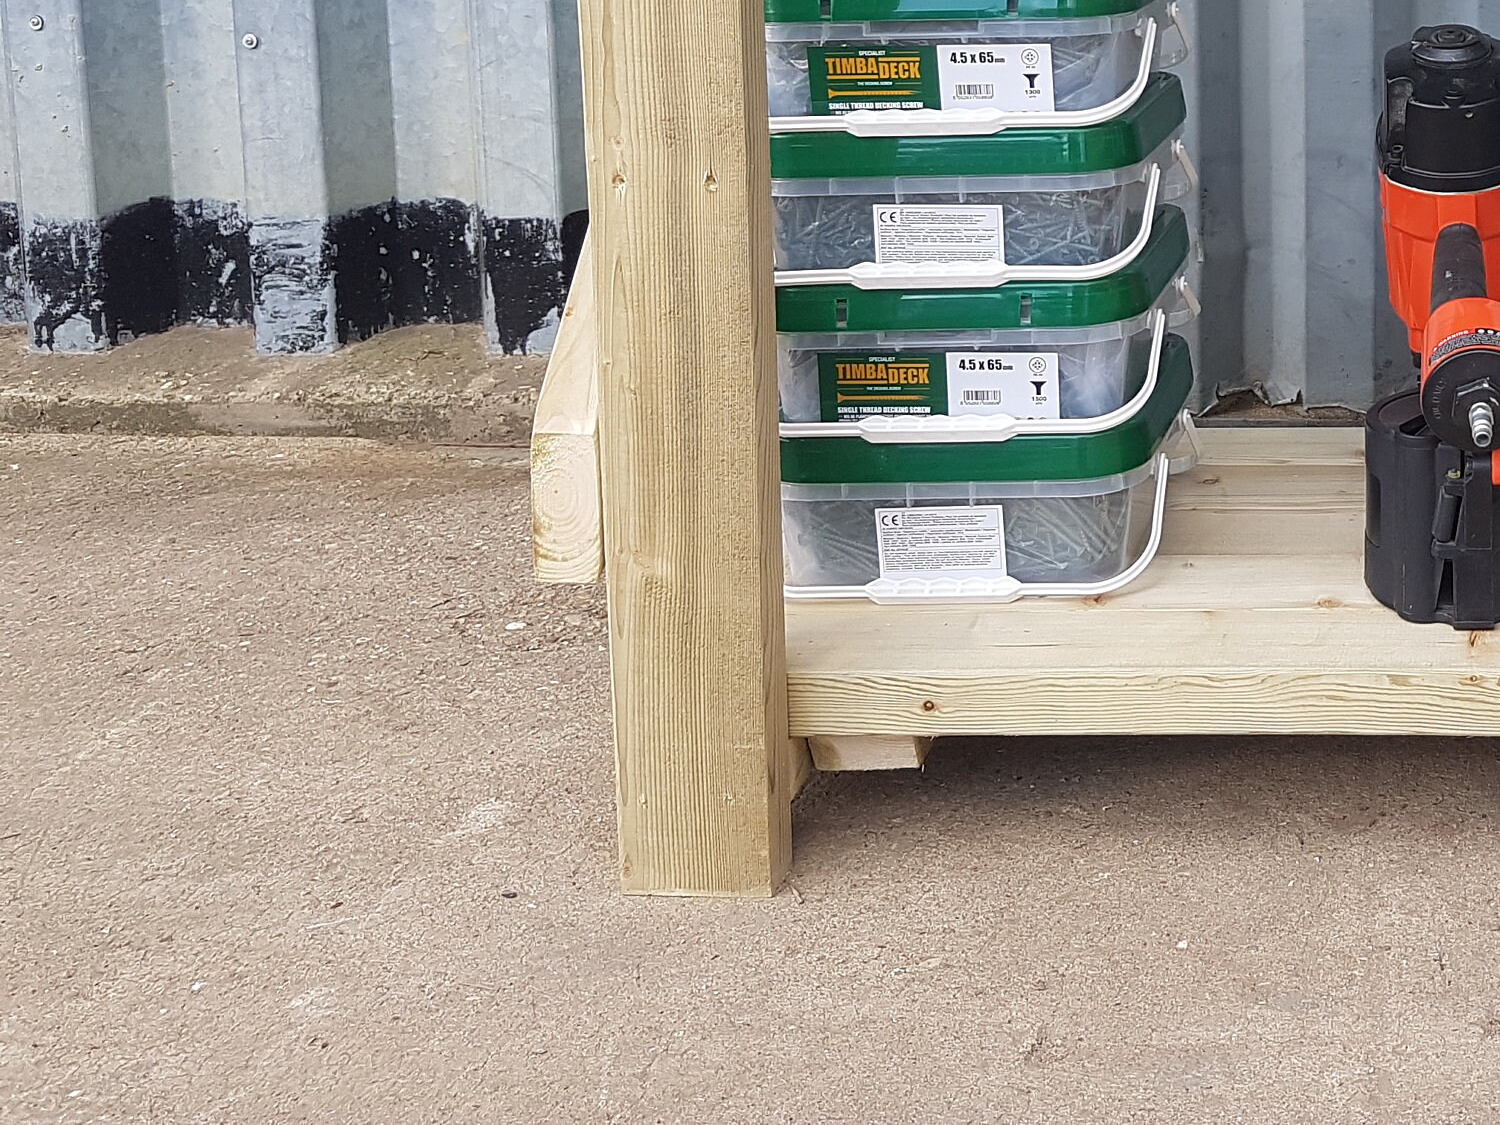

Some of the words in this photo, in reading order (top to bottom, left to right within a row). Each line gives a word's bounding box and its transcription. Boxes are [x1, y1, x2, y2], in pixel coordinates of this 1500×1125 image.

[950, 52, 968, 64] 4.5
[970, 54, 977, 63] x
[825, 57, 920, 79] TIMBADECK
[959, 359, 976, 371] 4.5
[979, 361, 985, 370] x
[836, 363, 930, 384] TIMBADECK
